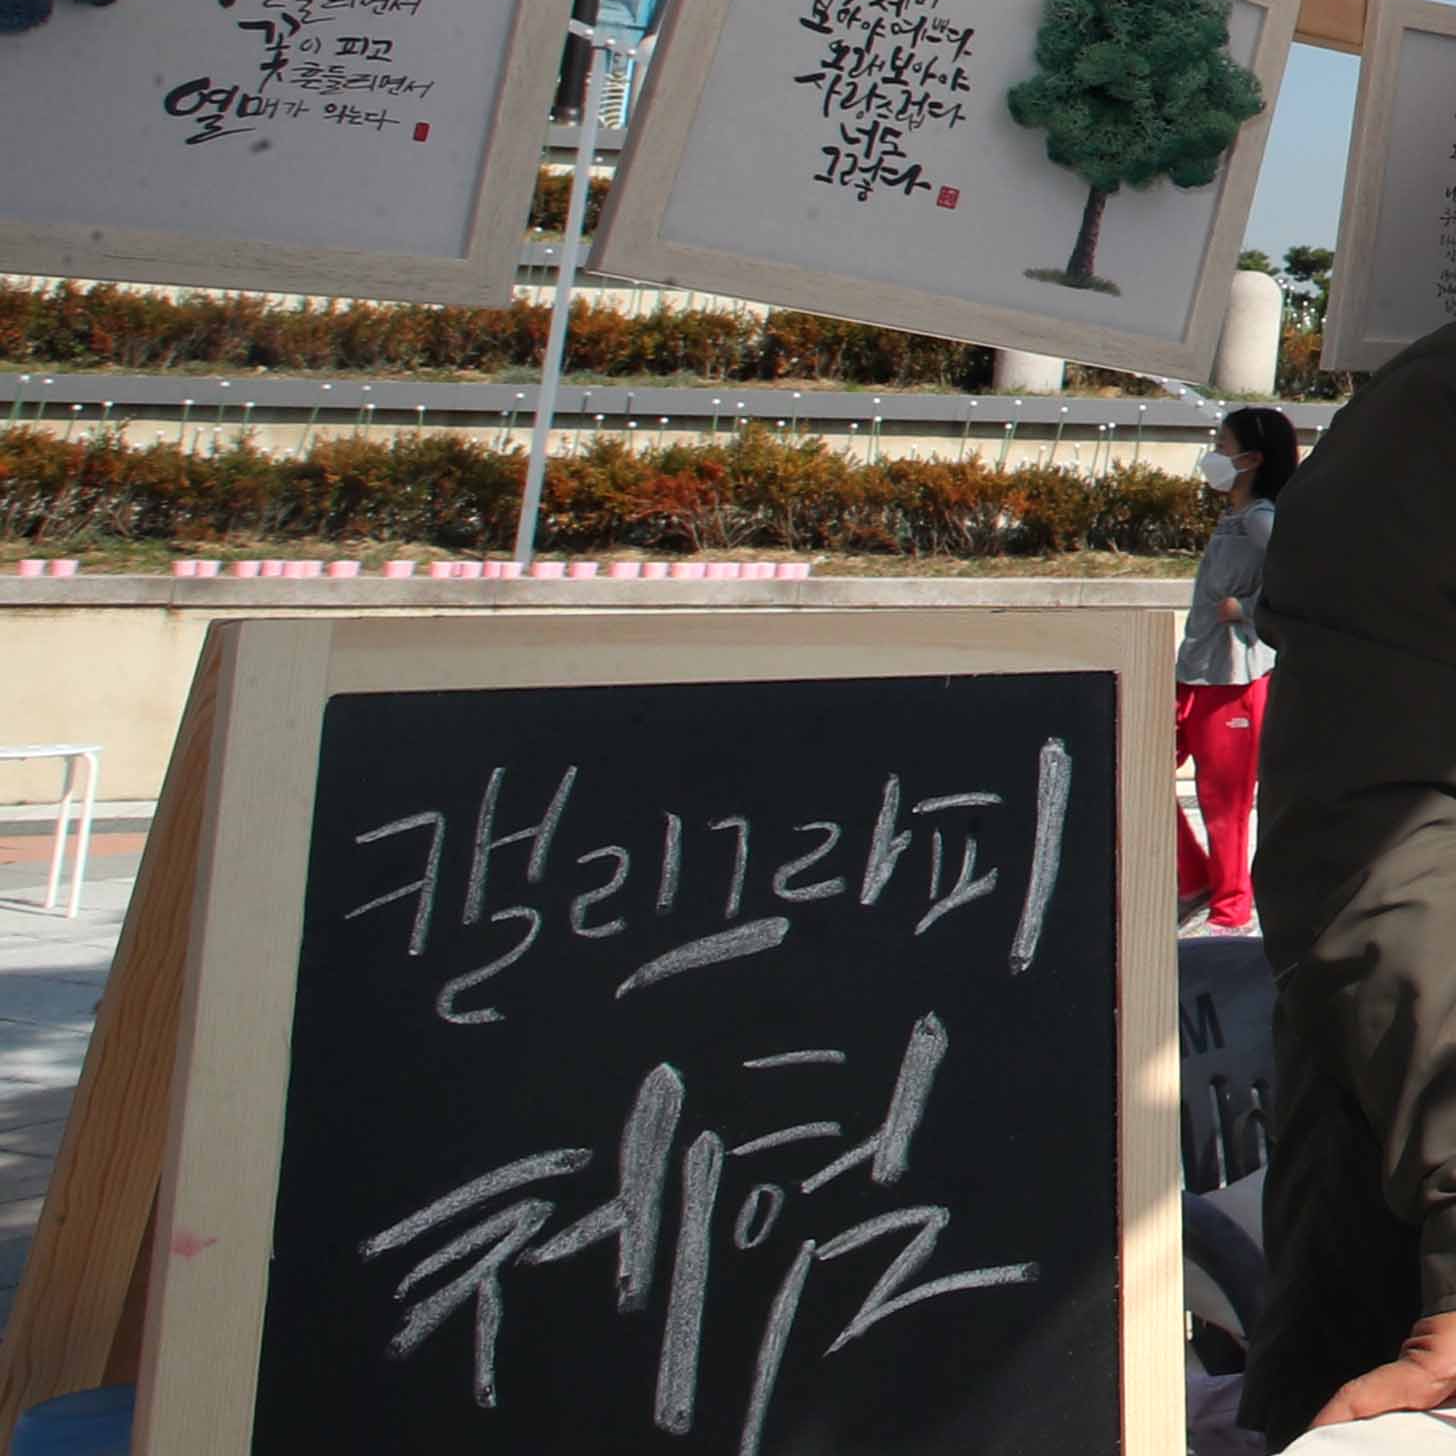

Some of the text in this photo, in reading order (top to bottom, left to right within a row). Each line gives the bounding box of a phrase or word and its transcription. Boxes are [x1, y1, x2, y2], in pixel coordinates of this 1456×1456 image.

[238, 12, 394, 94] 꽃이 피고
[289, 61, 435, 100] 흔들리면서
[820, 39, 971, 92] 오래 보아야
[164, 77, 310, 144] 열매가
[794, 73, 967, 131] 사랑스럽다
[840, 120, 906, 159] 너도
[813, 146, 932, 202] 그렇다
[345, 737, 1072, 1025] 캘리그라피
[356, 1011, 1040, 1456] 체험
